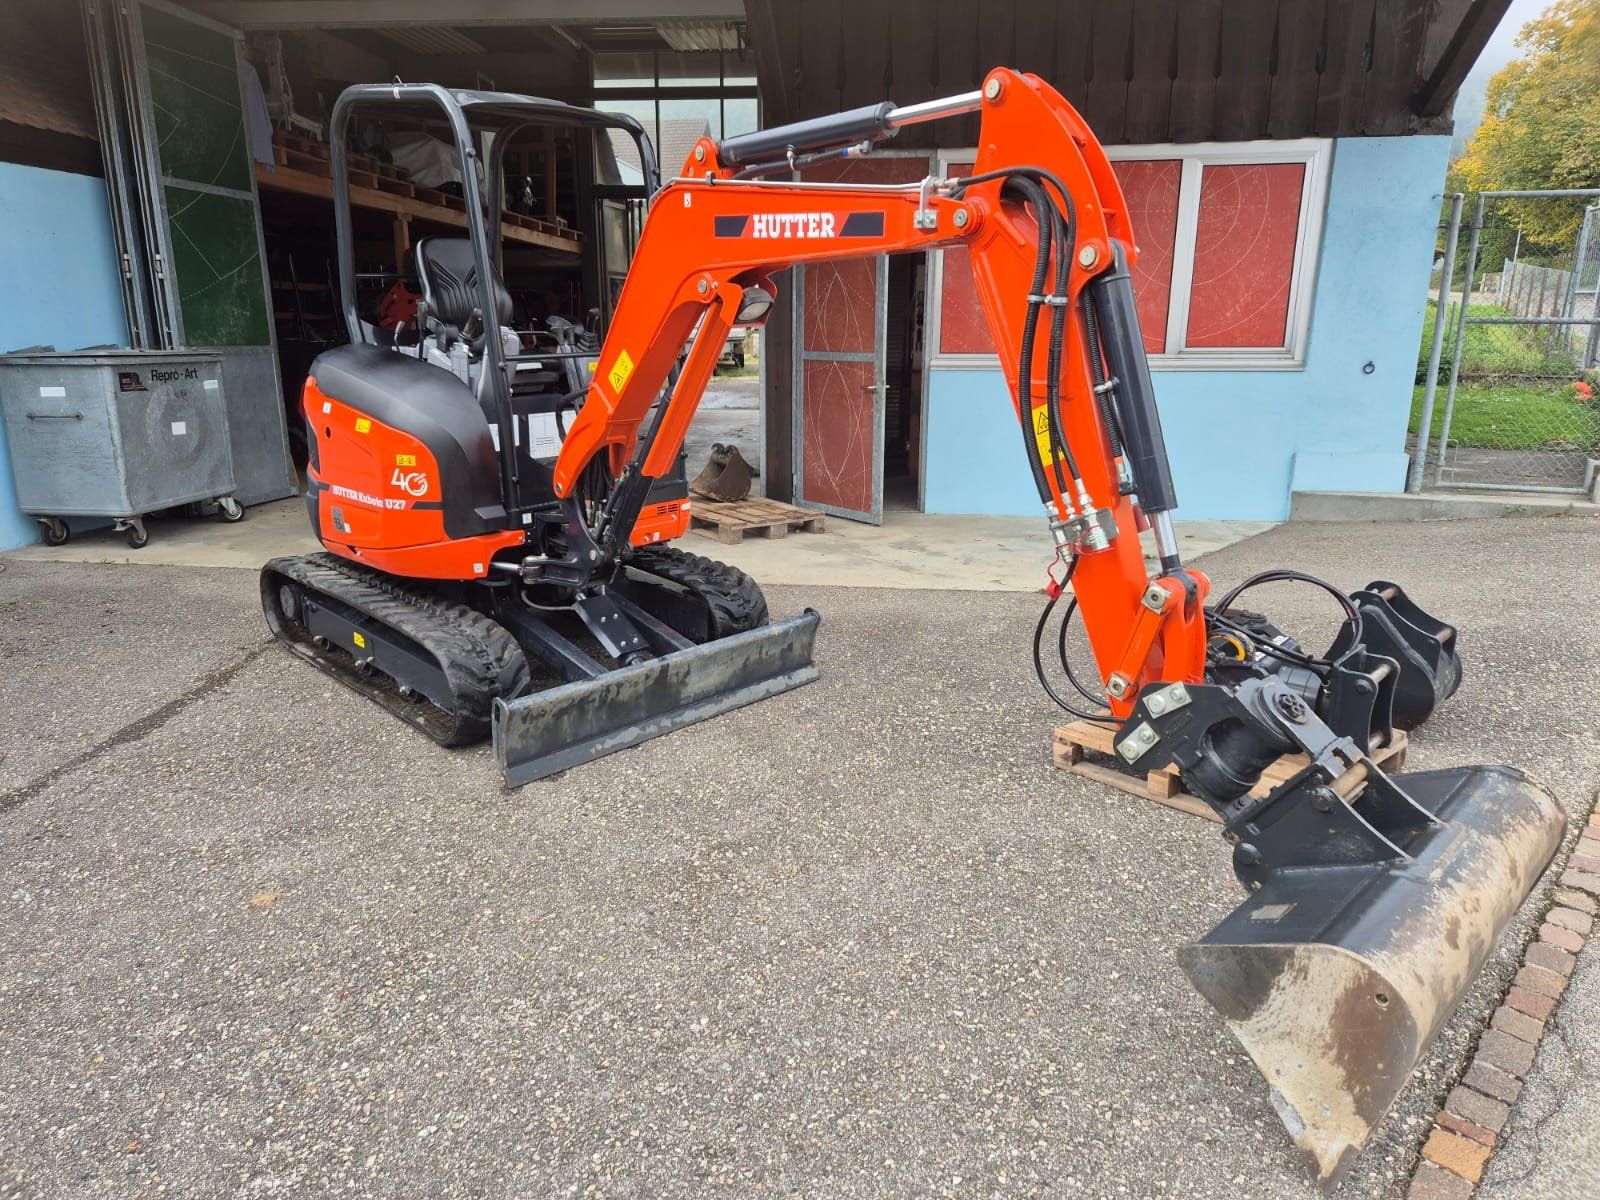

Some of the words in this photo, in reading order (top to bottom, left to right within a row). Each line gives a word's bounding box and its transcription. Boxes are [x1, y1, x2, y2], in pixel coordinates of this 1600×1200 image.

[752, 212, 835, 238] HUTTER
[332, 484, 358, 500] HUTTER
[385, 498, 406, 510] U27
